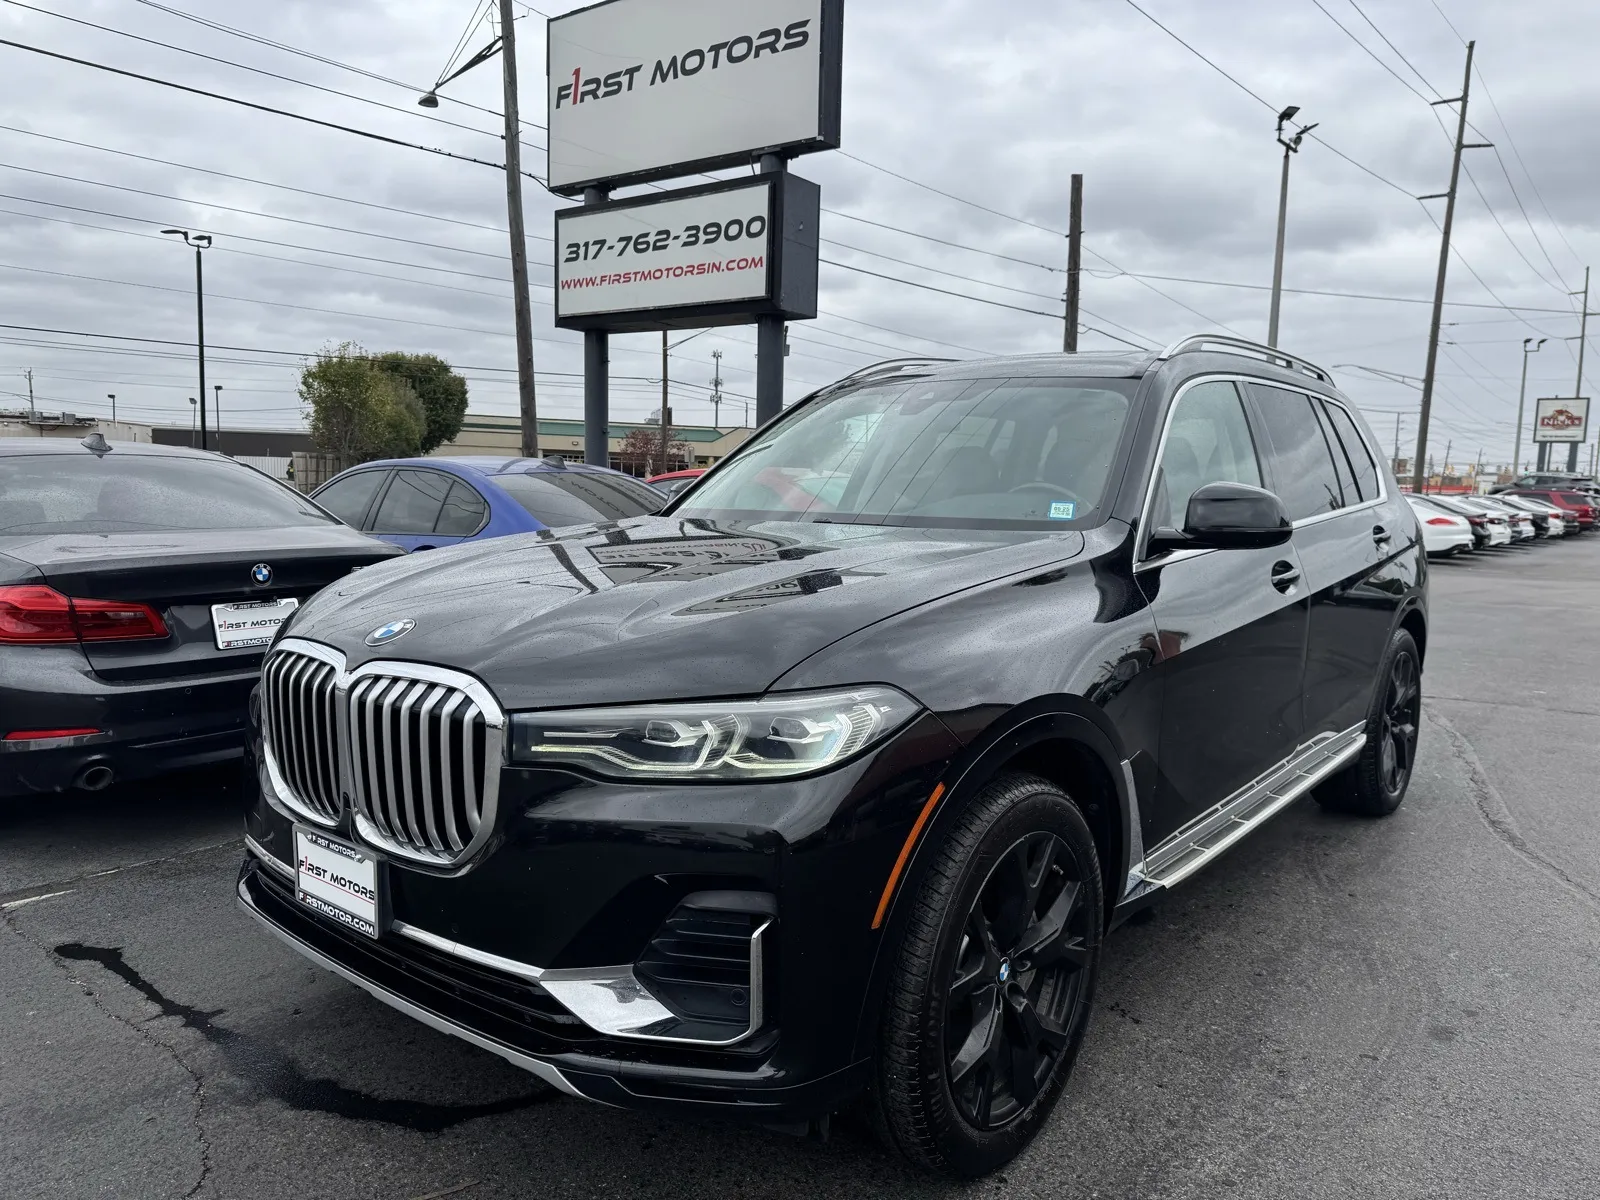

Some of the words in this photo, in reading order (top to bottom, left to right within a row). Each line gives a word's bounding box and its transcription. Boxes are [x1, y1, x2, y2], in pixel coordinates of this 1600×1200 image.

[649, 18, 812, 87] MOTORS
[563, 215, 767, 264] 317-762-3900
[560, 256, 764, 291] WWW.FIRSTMOTORSIN.COM
[329, 842, 356, 859] MOTORS
[329, 872, 375, 901] MOTORS
